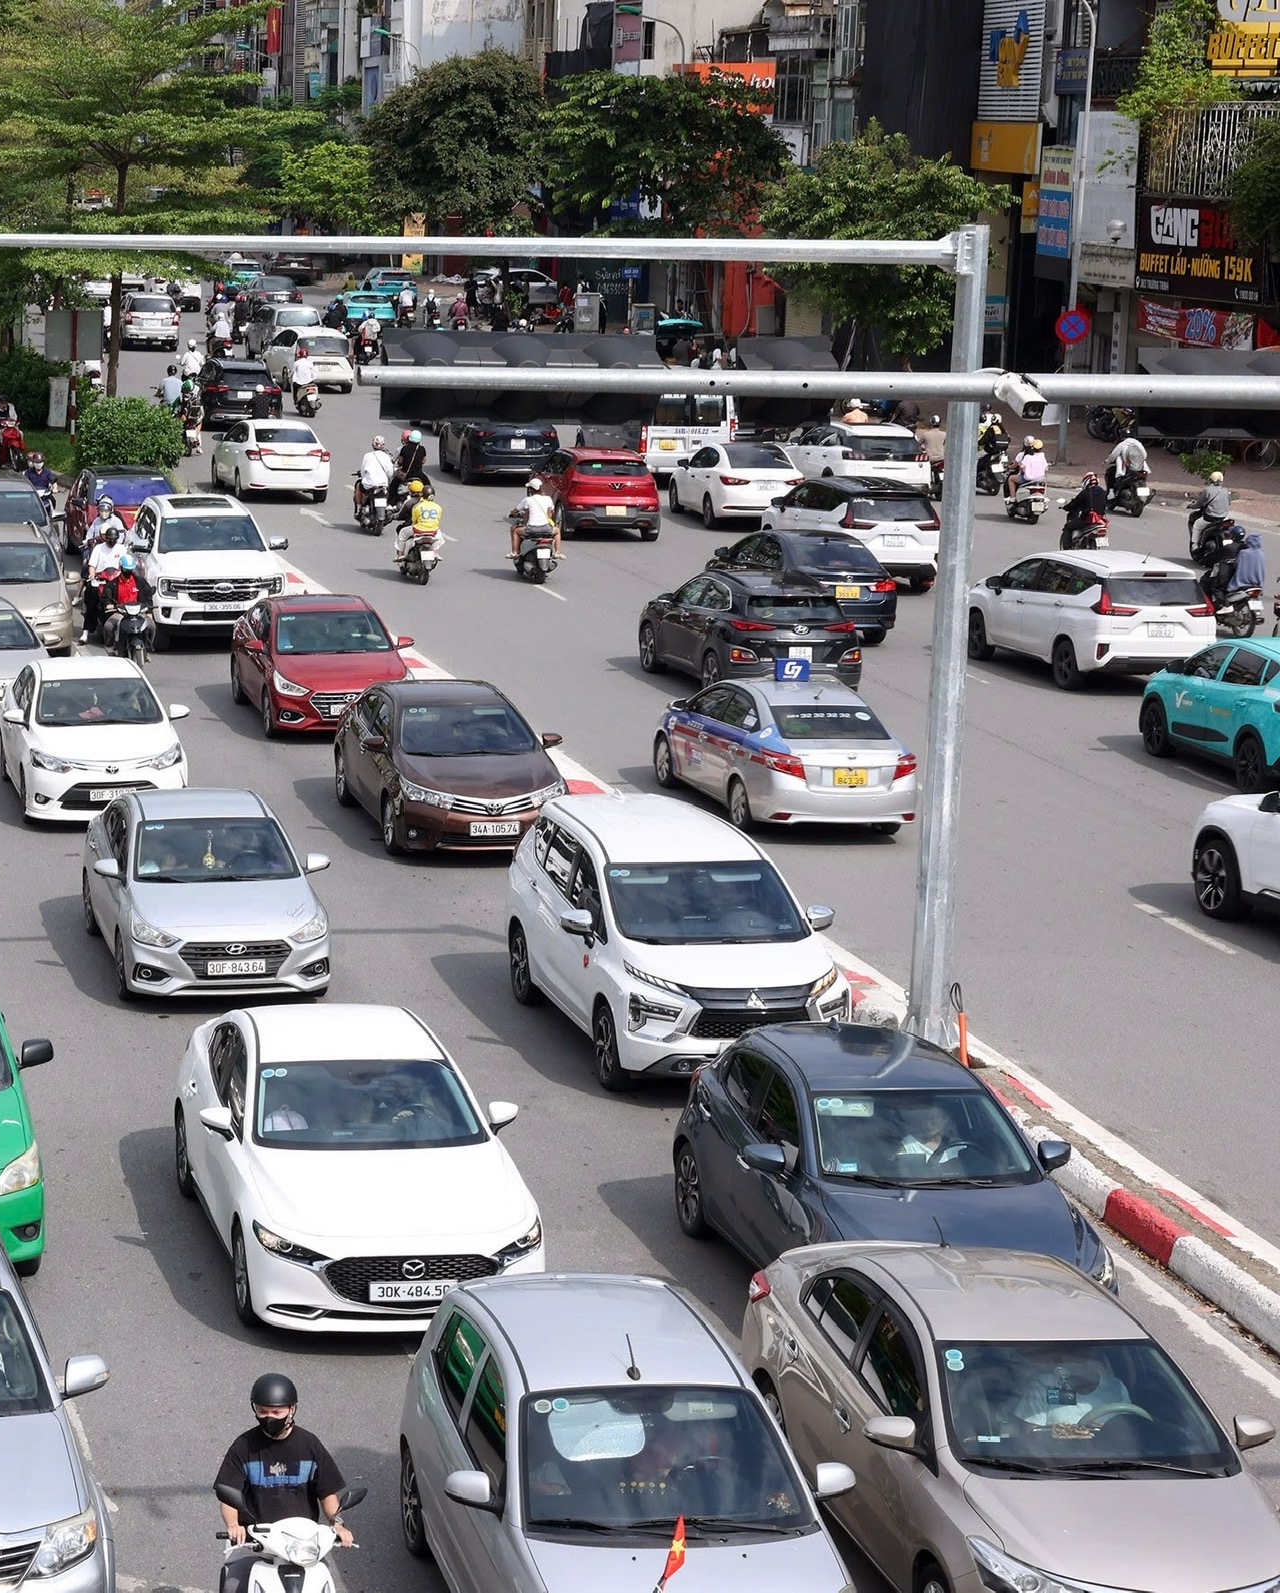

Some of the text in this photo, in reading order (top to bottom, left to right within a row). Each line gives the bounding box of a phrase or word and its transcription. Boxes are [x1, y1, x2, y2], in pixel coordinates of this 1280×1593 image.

[1207, 33, 1280, 59] BUFFET
[1150, 205, 1200, 247] GANG
[1139, 252, 1170, 273] BUFFET
[1171, 248, 1187, 275] LẨU
[1224, 255, 1254, 282] 159K
[1185, 307, 1217, 343] 20%
[420, 506, 438, 520] be
[784, 661, 803, 679] G7
[837, 777, 864, 785] 843.39
[472, 824, 518, 834] 34A-105.74
[209, 962, 264, 973] 30F-843.64
